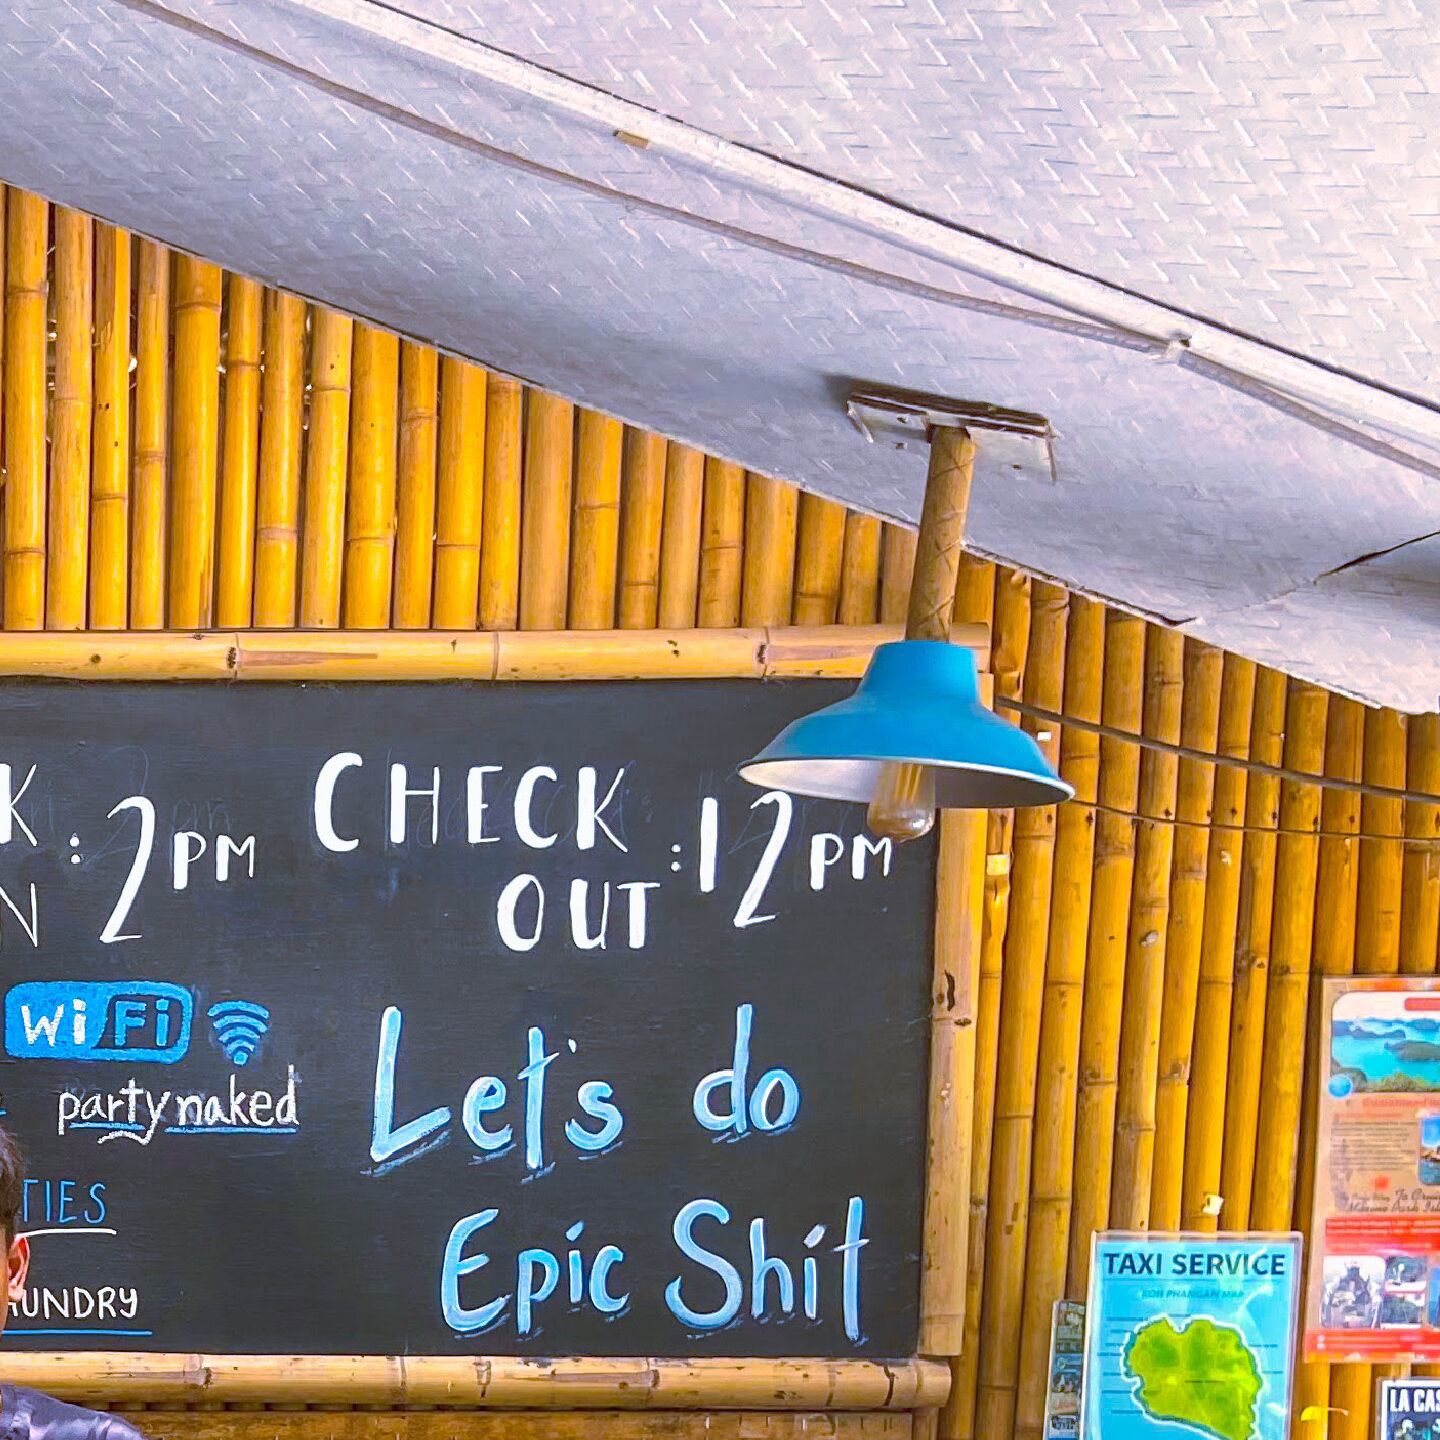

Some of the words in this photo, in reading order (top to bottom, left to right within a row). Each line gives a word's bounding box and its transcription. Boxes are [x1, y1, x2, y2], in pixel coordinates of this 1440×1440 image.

[314, 751, 629, 852] CHECK
[497, 874, 661, 951] OUT
[370, 1004, 623, 1172] Let's
[693, 1002, 802, 1135] do
[441, 1206, 630, 1336] Epic
[666, 1195, 870, 1340] Shit
[1103, 1253, 1162, 1275] TAXI
[1172, 1253, 1285, 1275] SERVICE
[8, 1286, 138, 1320] UNDRY
[1390, 1389, 1410, 1413] LA
